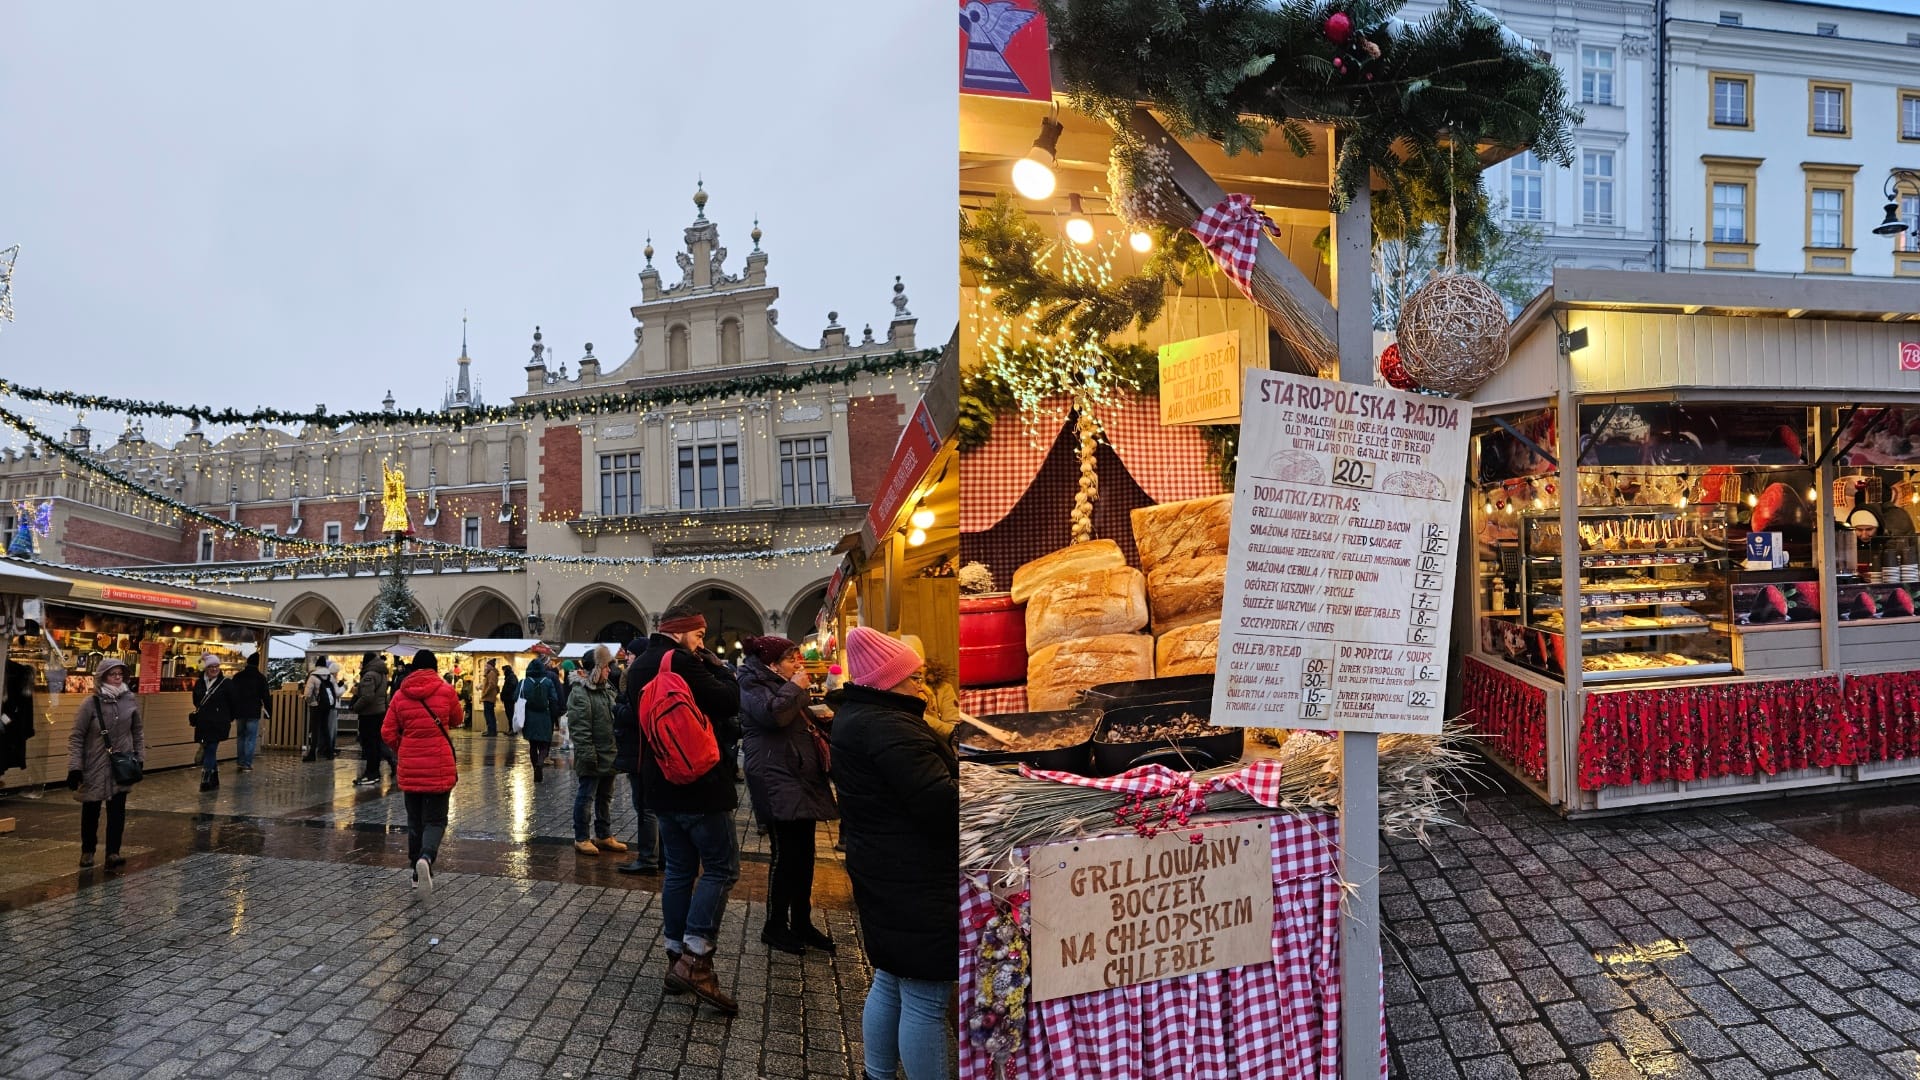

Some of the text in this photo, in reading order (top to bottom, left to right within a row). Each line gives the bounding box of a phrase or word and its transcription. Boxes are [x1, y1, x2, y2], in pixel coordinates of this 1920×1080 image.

[1163, 346, 1236, 384] SLICE OF BREAD
[1904, 350, 1920, 363] 78
[1173, 370, 1224, 400] WITH LARD
[1168, 389, 1231, 420] AND CUCUMBER
[1260, 379, 1459, 430] STAROPOLSKA PAJDA
[1282, 411, 1294, 421] ZE
[1296, 413, 1336, 428] SMALCEM
[1339, 419, 1354, 430] LUB
[1391, 427, 1435, 444] CZOSNKOWĄ
[1285, 424, 1431, 454] OLD POLISH STYLE SLICE OF BREAD
[1293, 438, 1421, 465] WITH LARD OR GARLIC BUTTER
[1334, 459, 1372, 485] 20,-
[1252, 506, 1308, 521] GRILLOWANY
[1309, 512, 1339, 525] BOCZEK
[1348, 517, 1385, 530] GRILLED
[1387, 521, 1411, 533] BACON
[1250, 524, 1288, 537] SMAŻONA
[1291, 528, 1332, 542] KIEŁBASA
[1342, 534, 1367, 545] FRIED
[1369, 536, 1402, 549] SAUSAGE
[1248, 543, 1295, 555] GRILLOWANE
[1296, 547, 1335, 560] PIECZARKI
[1342, 552, 1373, 563] GRILLED
[1374, 555, 1411, 567] MUSHROOMS
[1246, 560, 1285, 574] SMAŻONA
[1287, 564, 1318, 577] CEBULA
[1328, 568, 1353, 580] FRIED
[1356, 571, 1379, 582] ONION
[1244, 577, 1279, 591] OGÓREK
[1281, 582, 1315, 595] KISZONY
[1323, 586, 1355, 598] PICKLE
[1243, 594, 1275, 609] ŚWIEŻE
[1276, 599, 1316, 612] WARZYWA
[1326, 604, 1353, 616] FRESH
[1354, 606, 1401, 619] VEGETABLES
[1240, 617, 1298, 631] SZCZYPIOREK
[1306, 621, 1335, 633] CHIVES
[1232, 643, 1302, 657] CHLEB/BREAD
[1340, 646, 1352, 658] DO
[1354, 647, 1393, 660] POPICIA
[1406, 651, 1432, 663] SOUPS
[1230, 661, 1248, 670] CAŁY
[1256, 662, 1280, 671] WHOLE
[1363, 666, 1406, 677] STAROPOLSKI
[1265, 676, 1284, 685] HALF
[1225, 701, 1256, 711] KROMKA
[1264, 704, 1285, 712] SLICE
[1335, 701, 1341, 709] Z
[1361, 692, 1404, 702] STAROPOLSKI
[1070, 836, 1240, 897] GRILLOWANY
[1110, 875, 1206, 921] BOCZEK
[1060, 896, 1253, 968] NA CHŁOPSKIM
[1103, 937, 1215, 987] CHLEBIE
